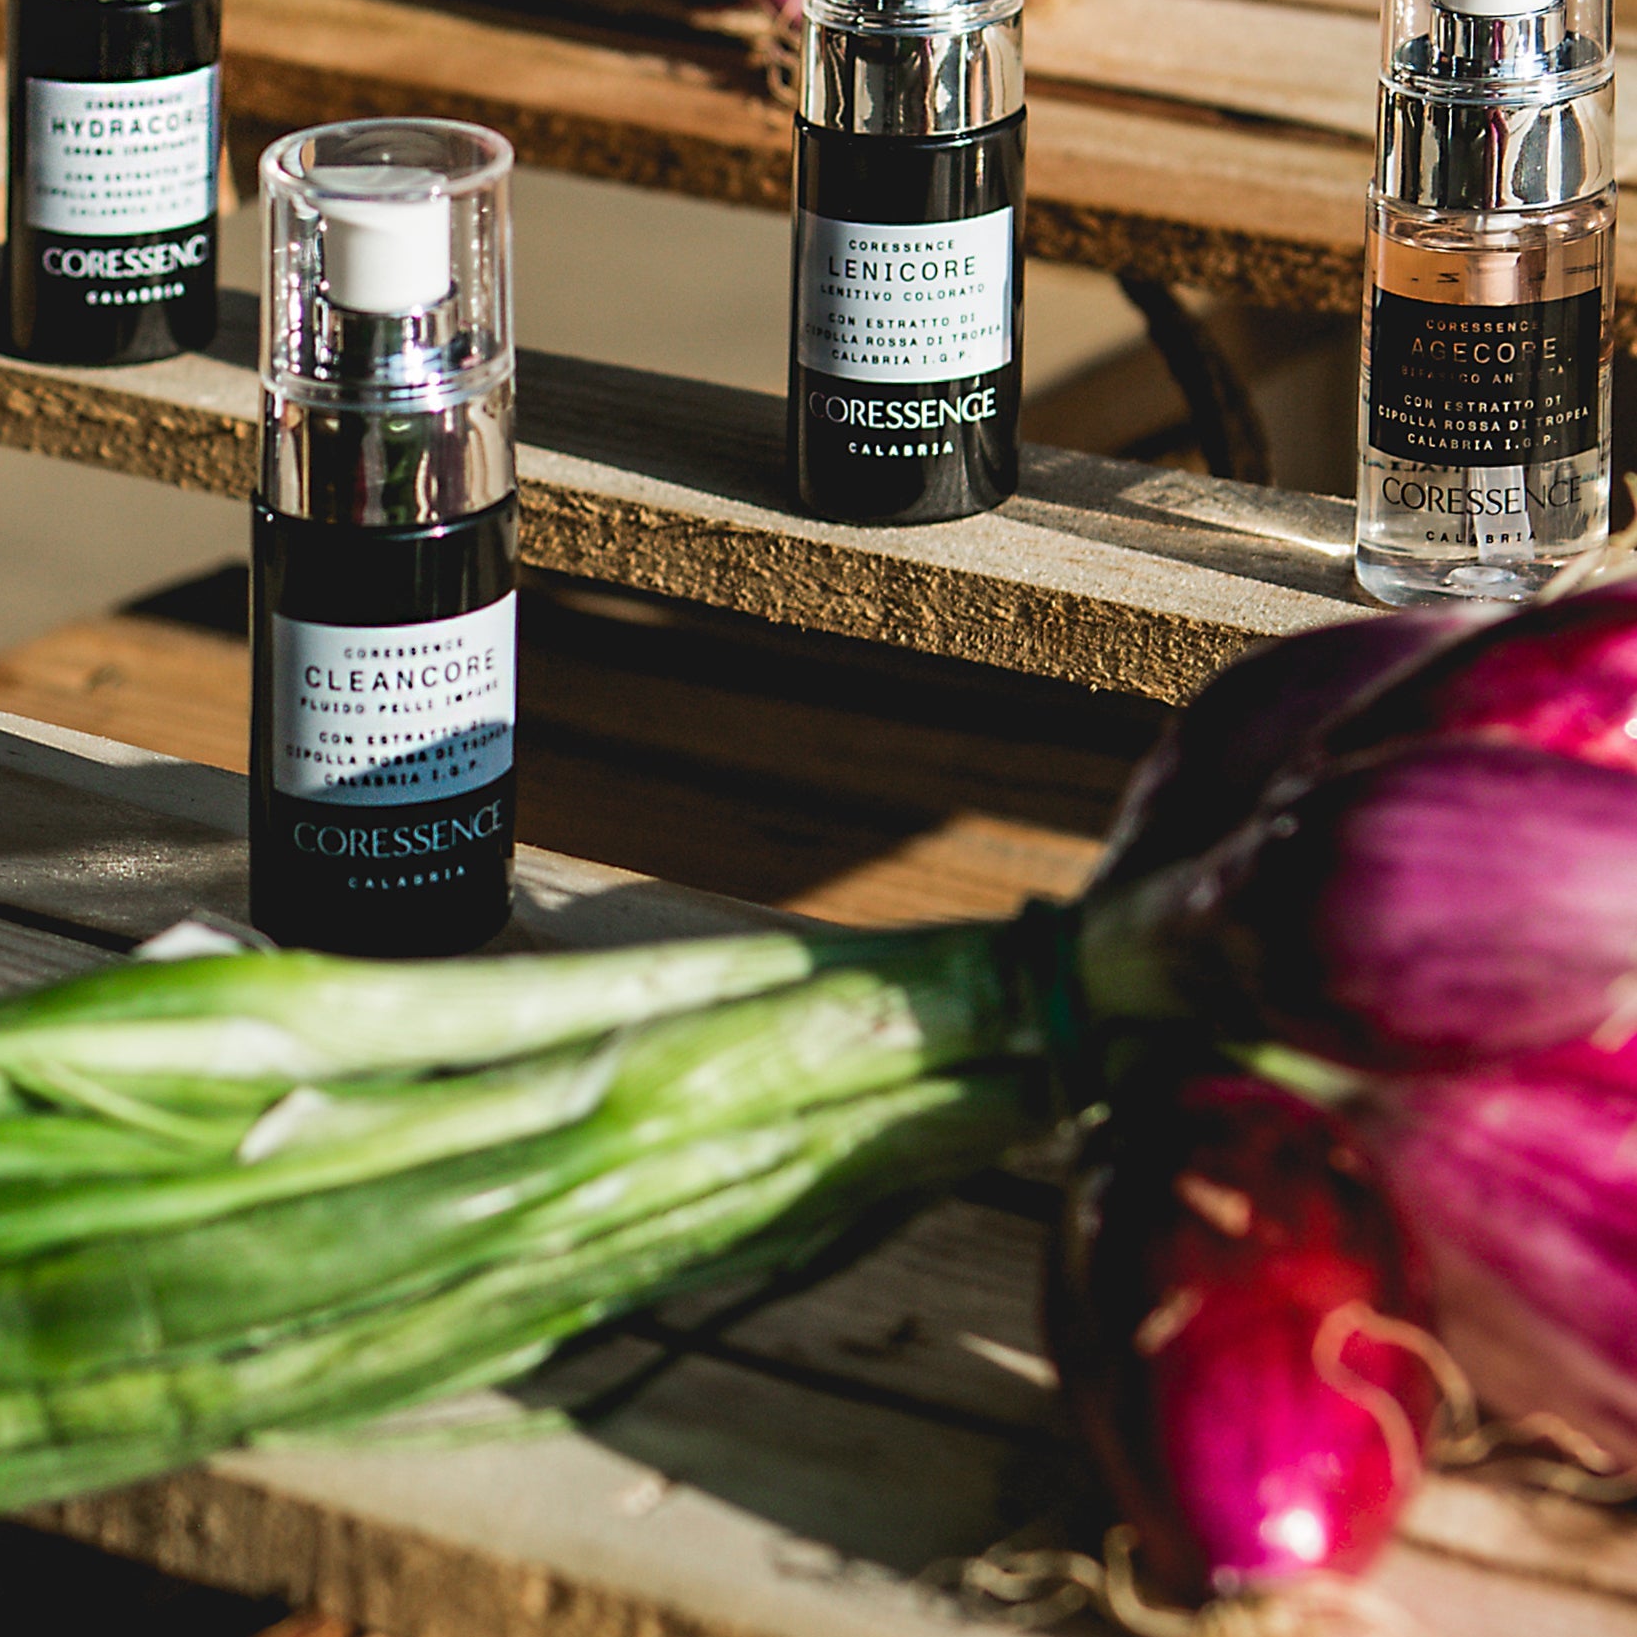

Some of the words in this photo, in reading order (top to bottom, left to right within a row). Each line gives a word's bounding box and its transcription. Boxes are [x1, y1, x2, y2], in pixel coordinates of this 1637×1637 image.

[848, 238, 956, 253] CORESSENCE
[828, 256, 977, 282] LENICORE
[820, 283, 893, 302] LENITIVO
[903, 283, 985, 302] COLORATO
[828, 312, 856, 327] CON
[866, 317, 950, 329] ESTRATTO
[960, 312, 976, 325] DI
[1426, 319, 1539, 334] CORESSENCE
[805, 323, 859, 345] CIPOLLA
[866, 336, 917, 347] ROSSA
[927, 335, 943, 346] DI
[831, 349, 910, 365] CALABRIA
[1411, 337, 1557, 365] AGECORE
[809, 387, 997, 430] CORESSENCE
[1404, 394, 1434, 410] CON
[1444, 399, 1535, 413] ESTRATTO
[1545, 394, 1563, 408] DI
[1377, 404, 1438, 429] CIPOLLA
[1444, 419, 1501, 432] ROSSA
[1509, 419, 1528, 432] DI
[1535, 406, 1590, 427] TROPEA
[848, 441, 955, 457] CALABRIA
[1407, 433, 1494, 451] CALABRIA
[1382, 475, 1582, 516] CORESSENCE
[1425, 530, 1537, 547] CALABRIA
[305, 647, 495, 692] CLEANCORE
[300, 696, 365, 714] FLUIDO
[379, 699, 433, 713] PELLI
[319, 731, 353, 745] CON
[286, 744, 356, 765] CIPOLLA
[436, 745, 454, 760] DI
[324, 772, 420, 788] CALABRIA
[294, 799, 503, 858] CORESSENCE
[348, 865, 466, 890] CALABRIA
